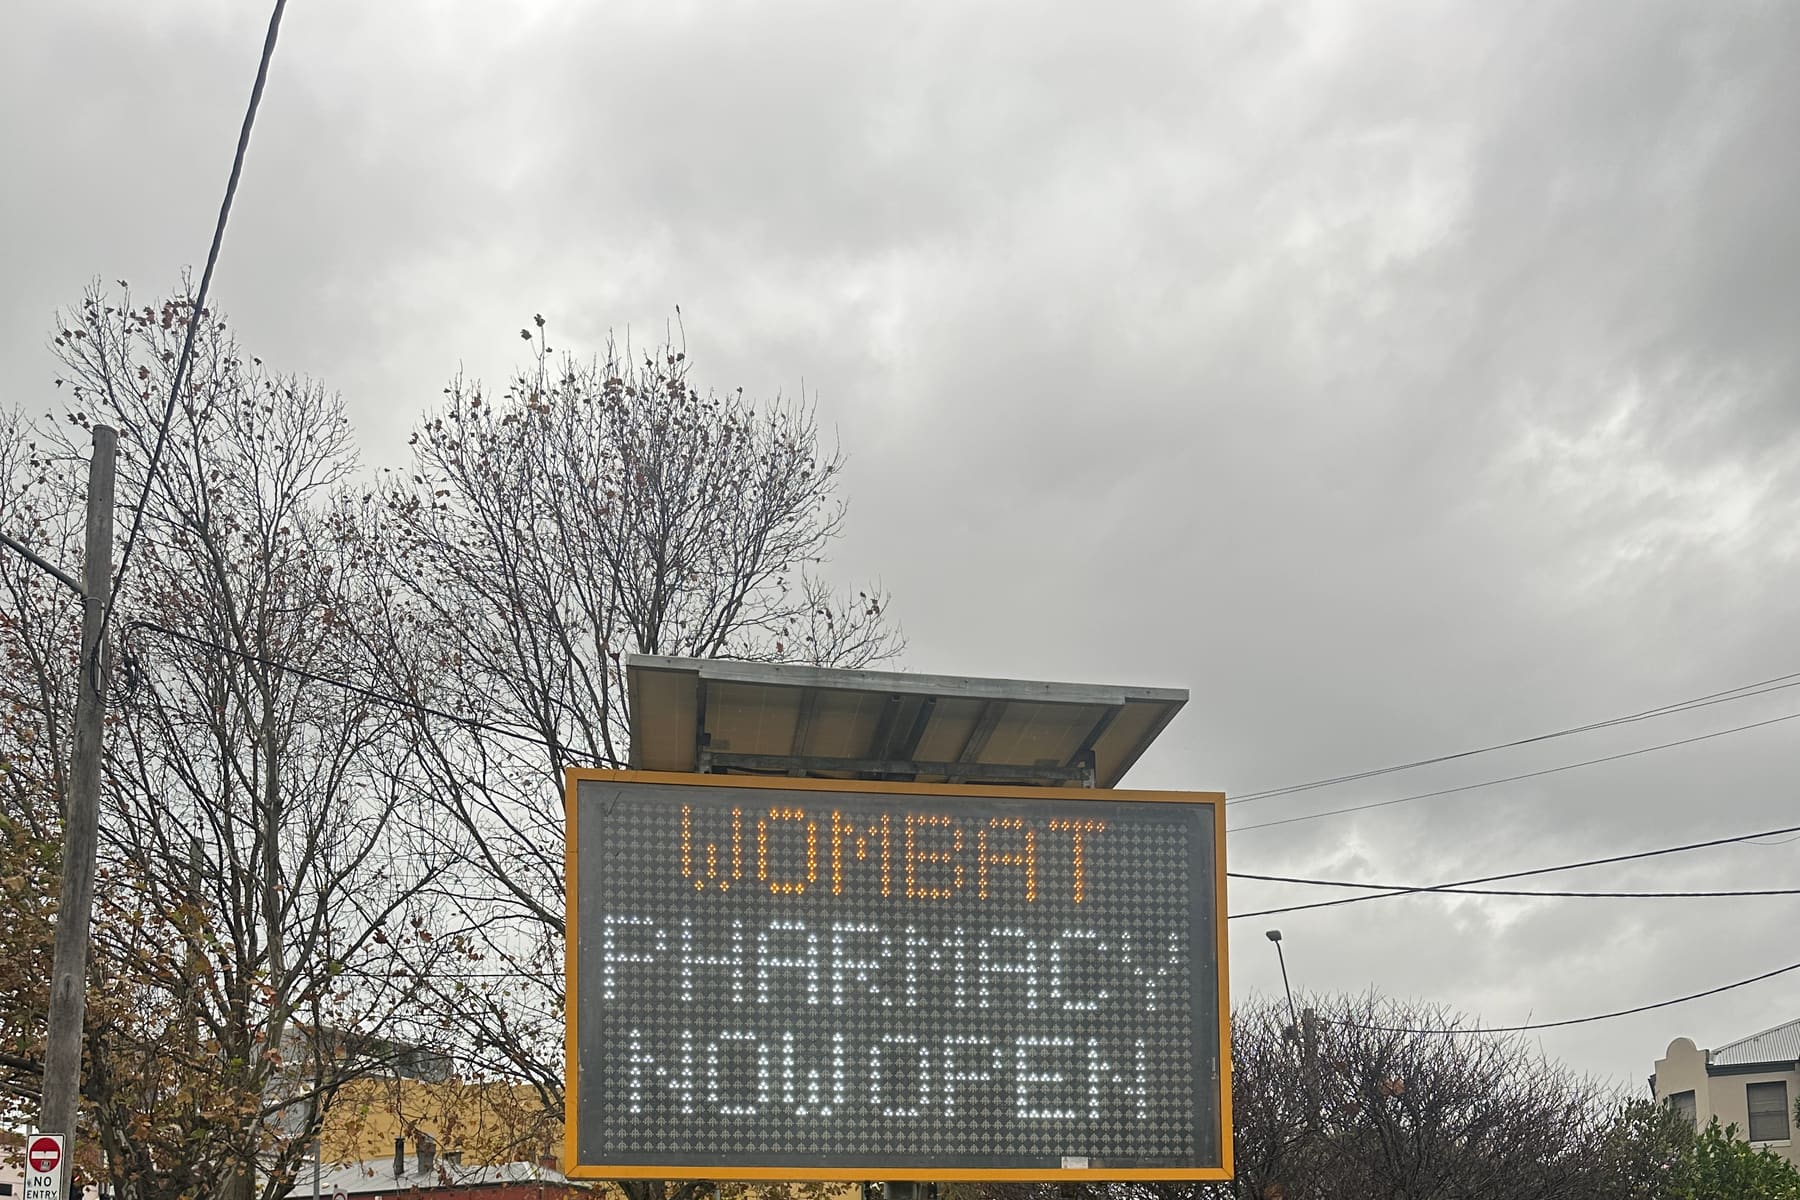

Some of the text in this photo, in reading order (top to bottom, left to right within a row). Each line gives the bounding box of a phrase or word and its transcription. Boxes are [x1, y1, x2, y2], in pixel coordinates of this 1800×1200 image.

[681, 805, 1105, 903] WOMBAT
[603, 914, 1178, 1011] PHARMACY
[629, 1029, 1147, 1119] NOW OPEN
[26, 1190, 58, 1199] ENTRY
[34, 1176, 52, 1187] NO
